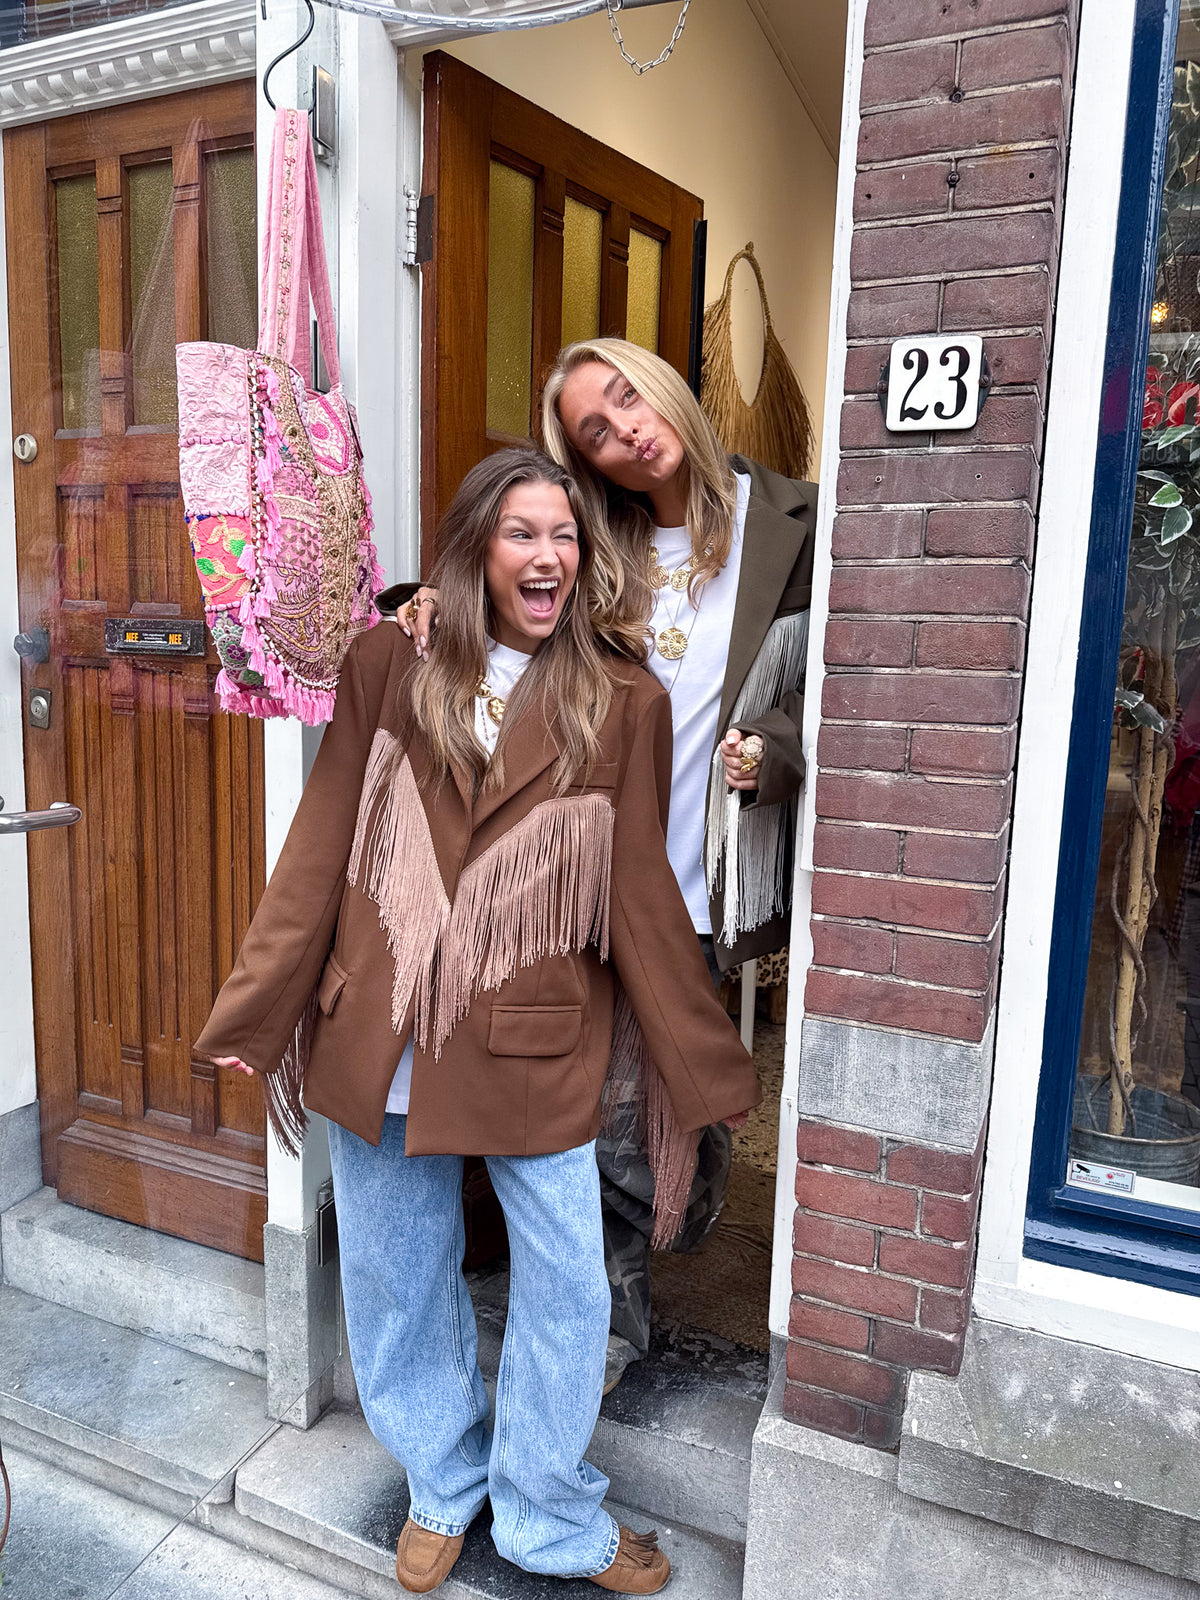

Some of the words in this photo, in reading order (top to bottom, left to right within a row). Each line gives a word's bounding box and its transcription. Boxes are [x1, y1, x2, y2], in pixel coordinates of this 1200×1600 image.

[899, 345, 970, 422] 23
[126, 632, 139, 642] NEE
[168, 633, 182, 645] NEE
